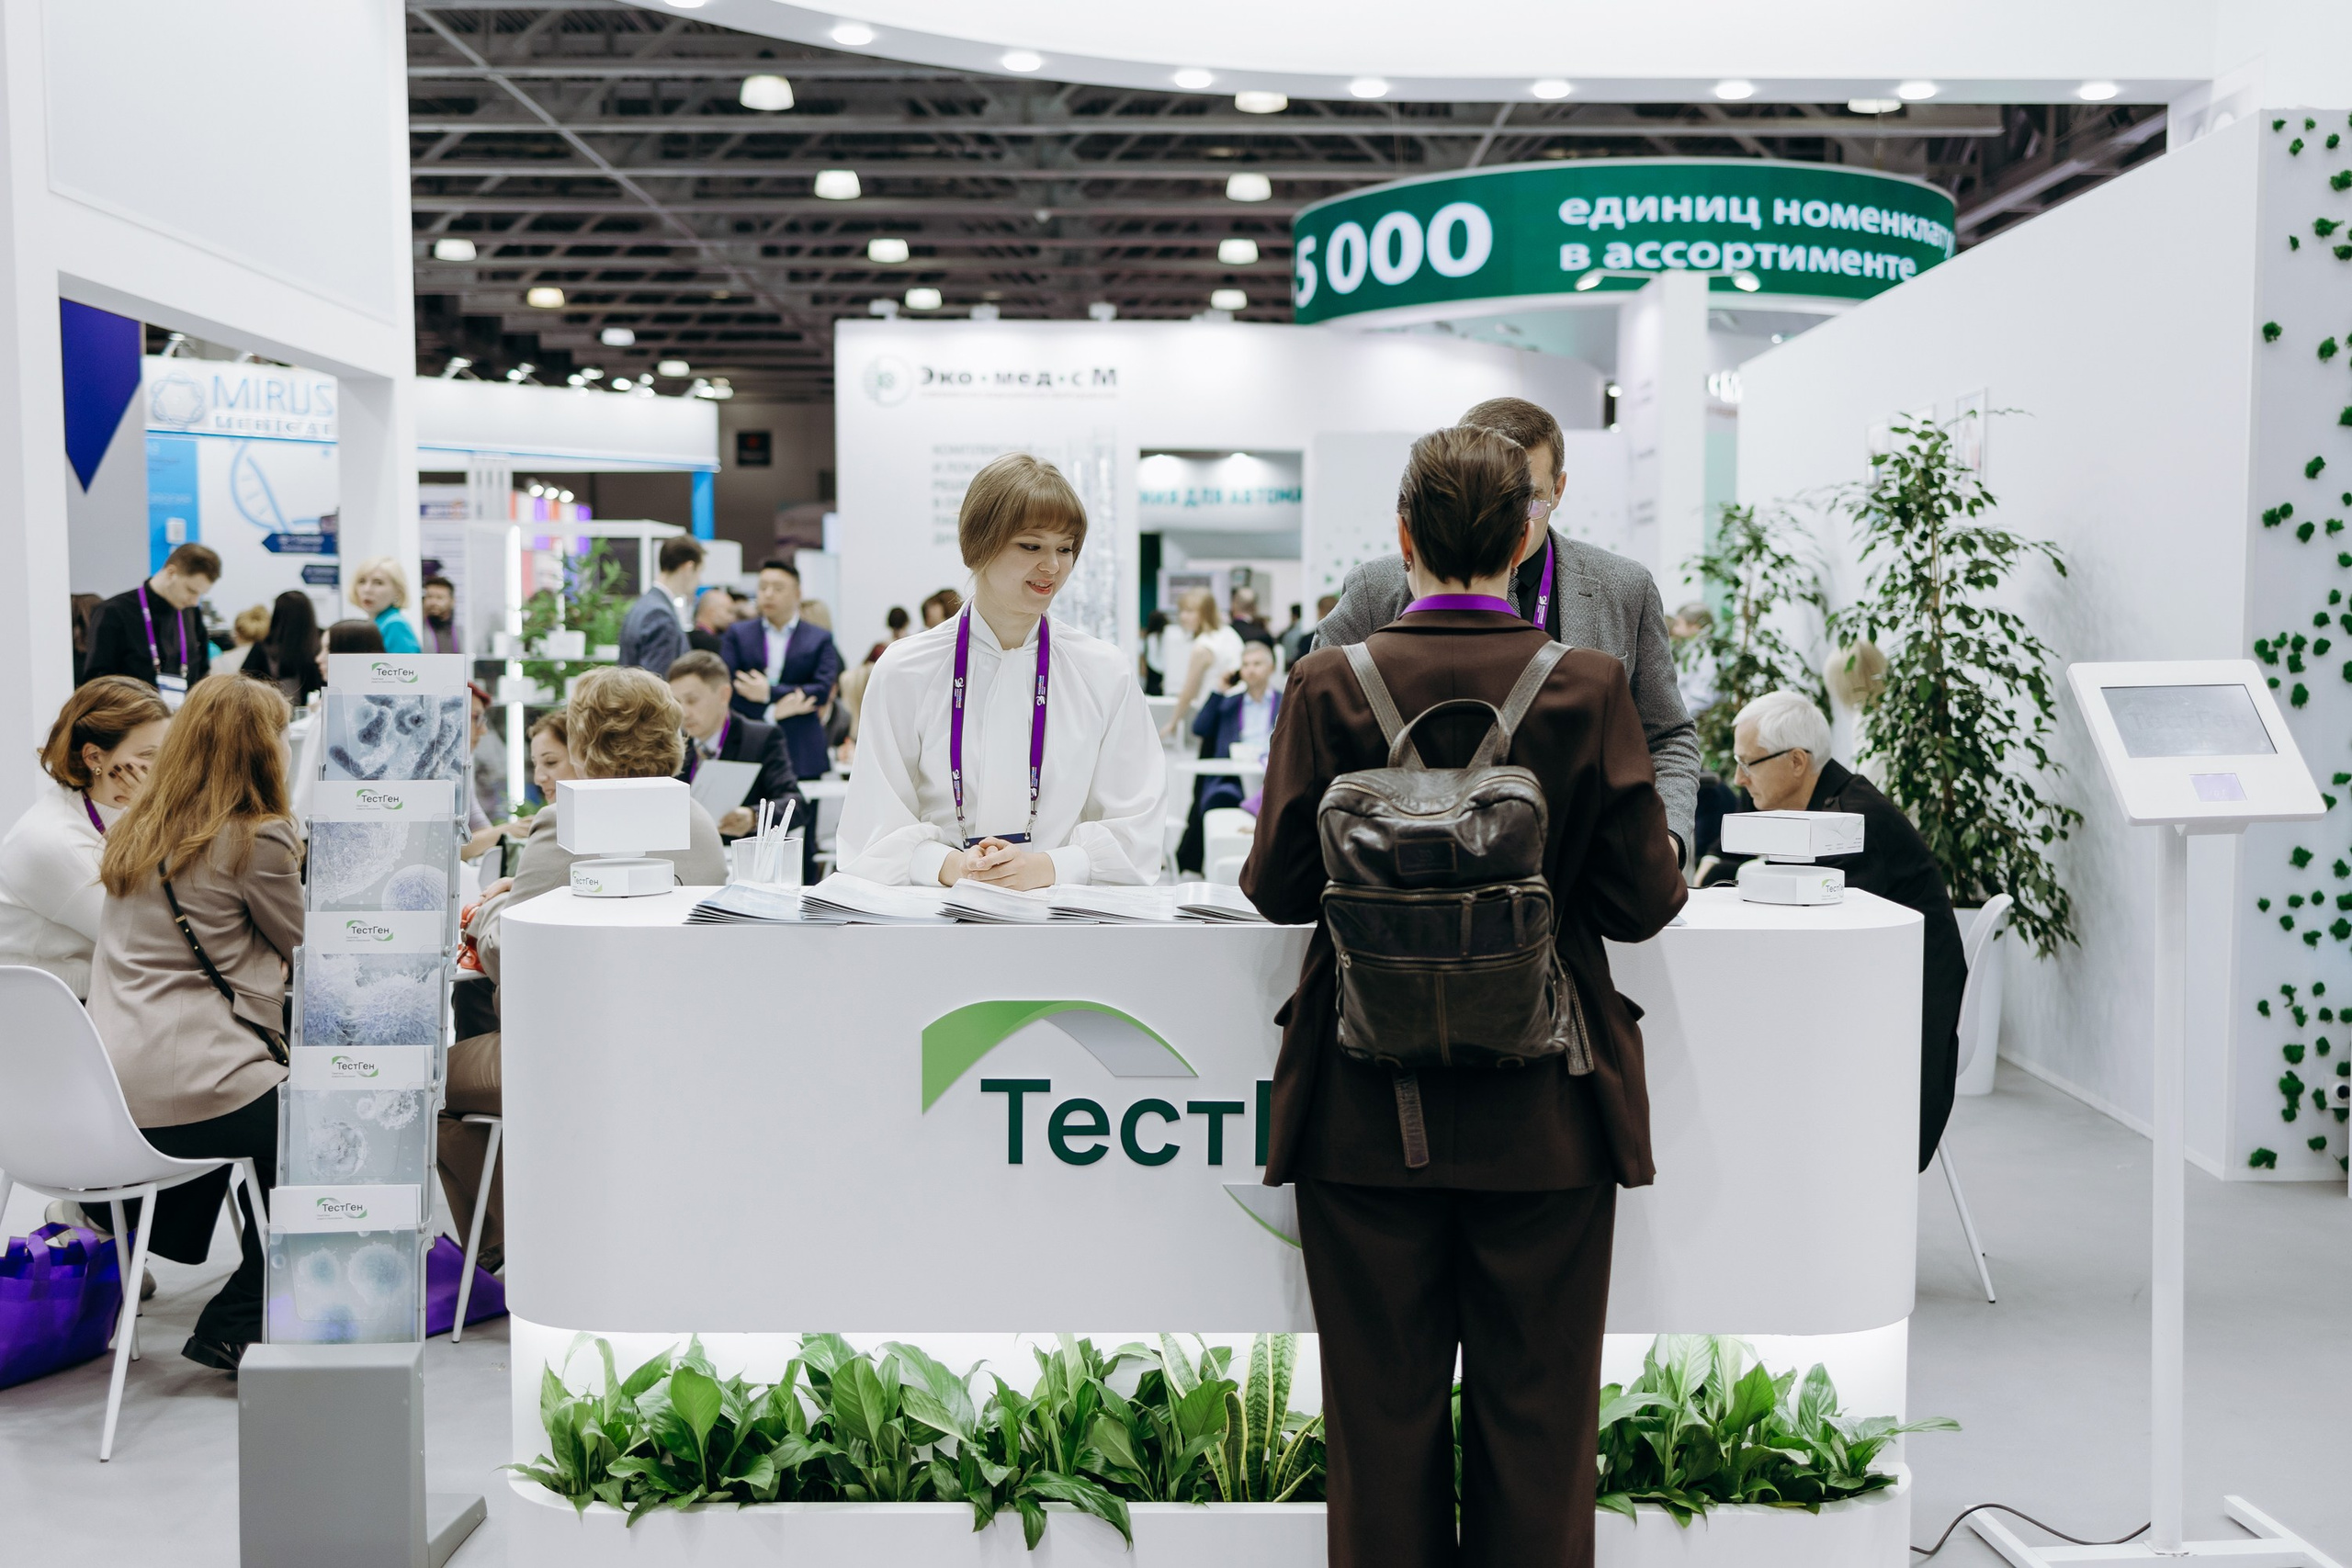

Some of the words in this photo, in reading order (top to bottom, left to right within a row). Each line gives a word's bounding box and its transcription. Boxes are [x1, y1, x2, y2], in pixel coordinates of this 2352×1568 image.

[1558, 196, 1762, 231] единиц
[1325, 200, 1493, 295] 000
[1560, 243, 1591, 272] в
[1603, 241, 1917, 281] ассортименте
[212, 375, 334, 417] MIRUS
[376, 668, 414, 676] ТестГен
[361, 795, 400, 803] ТестГен
[573, 876, 599, 886] ТестГен
[351, 926, 390, 934] ТестГен
[336, 1062, 375, 1070] ТестГен
[322, 1203, 363, 1213] ТестГен
